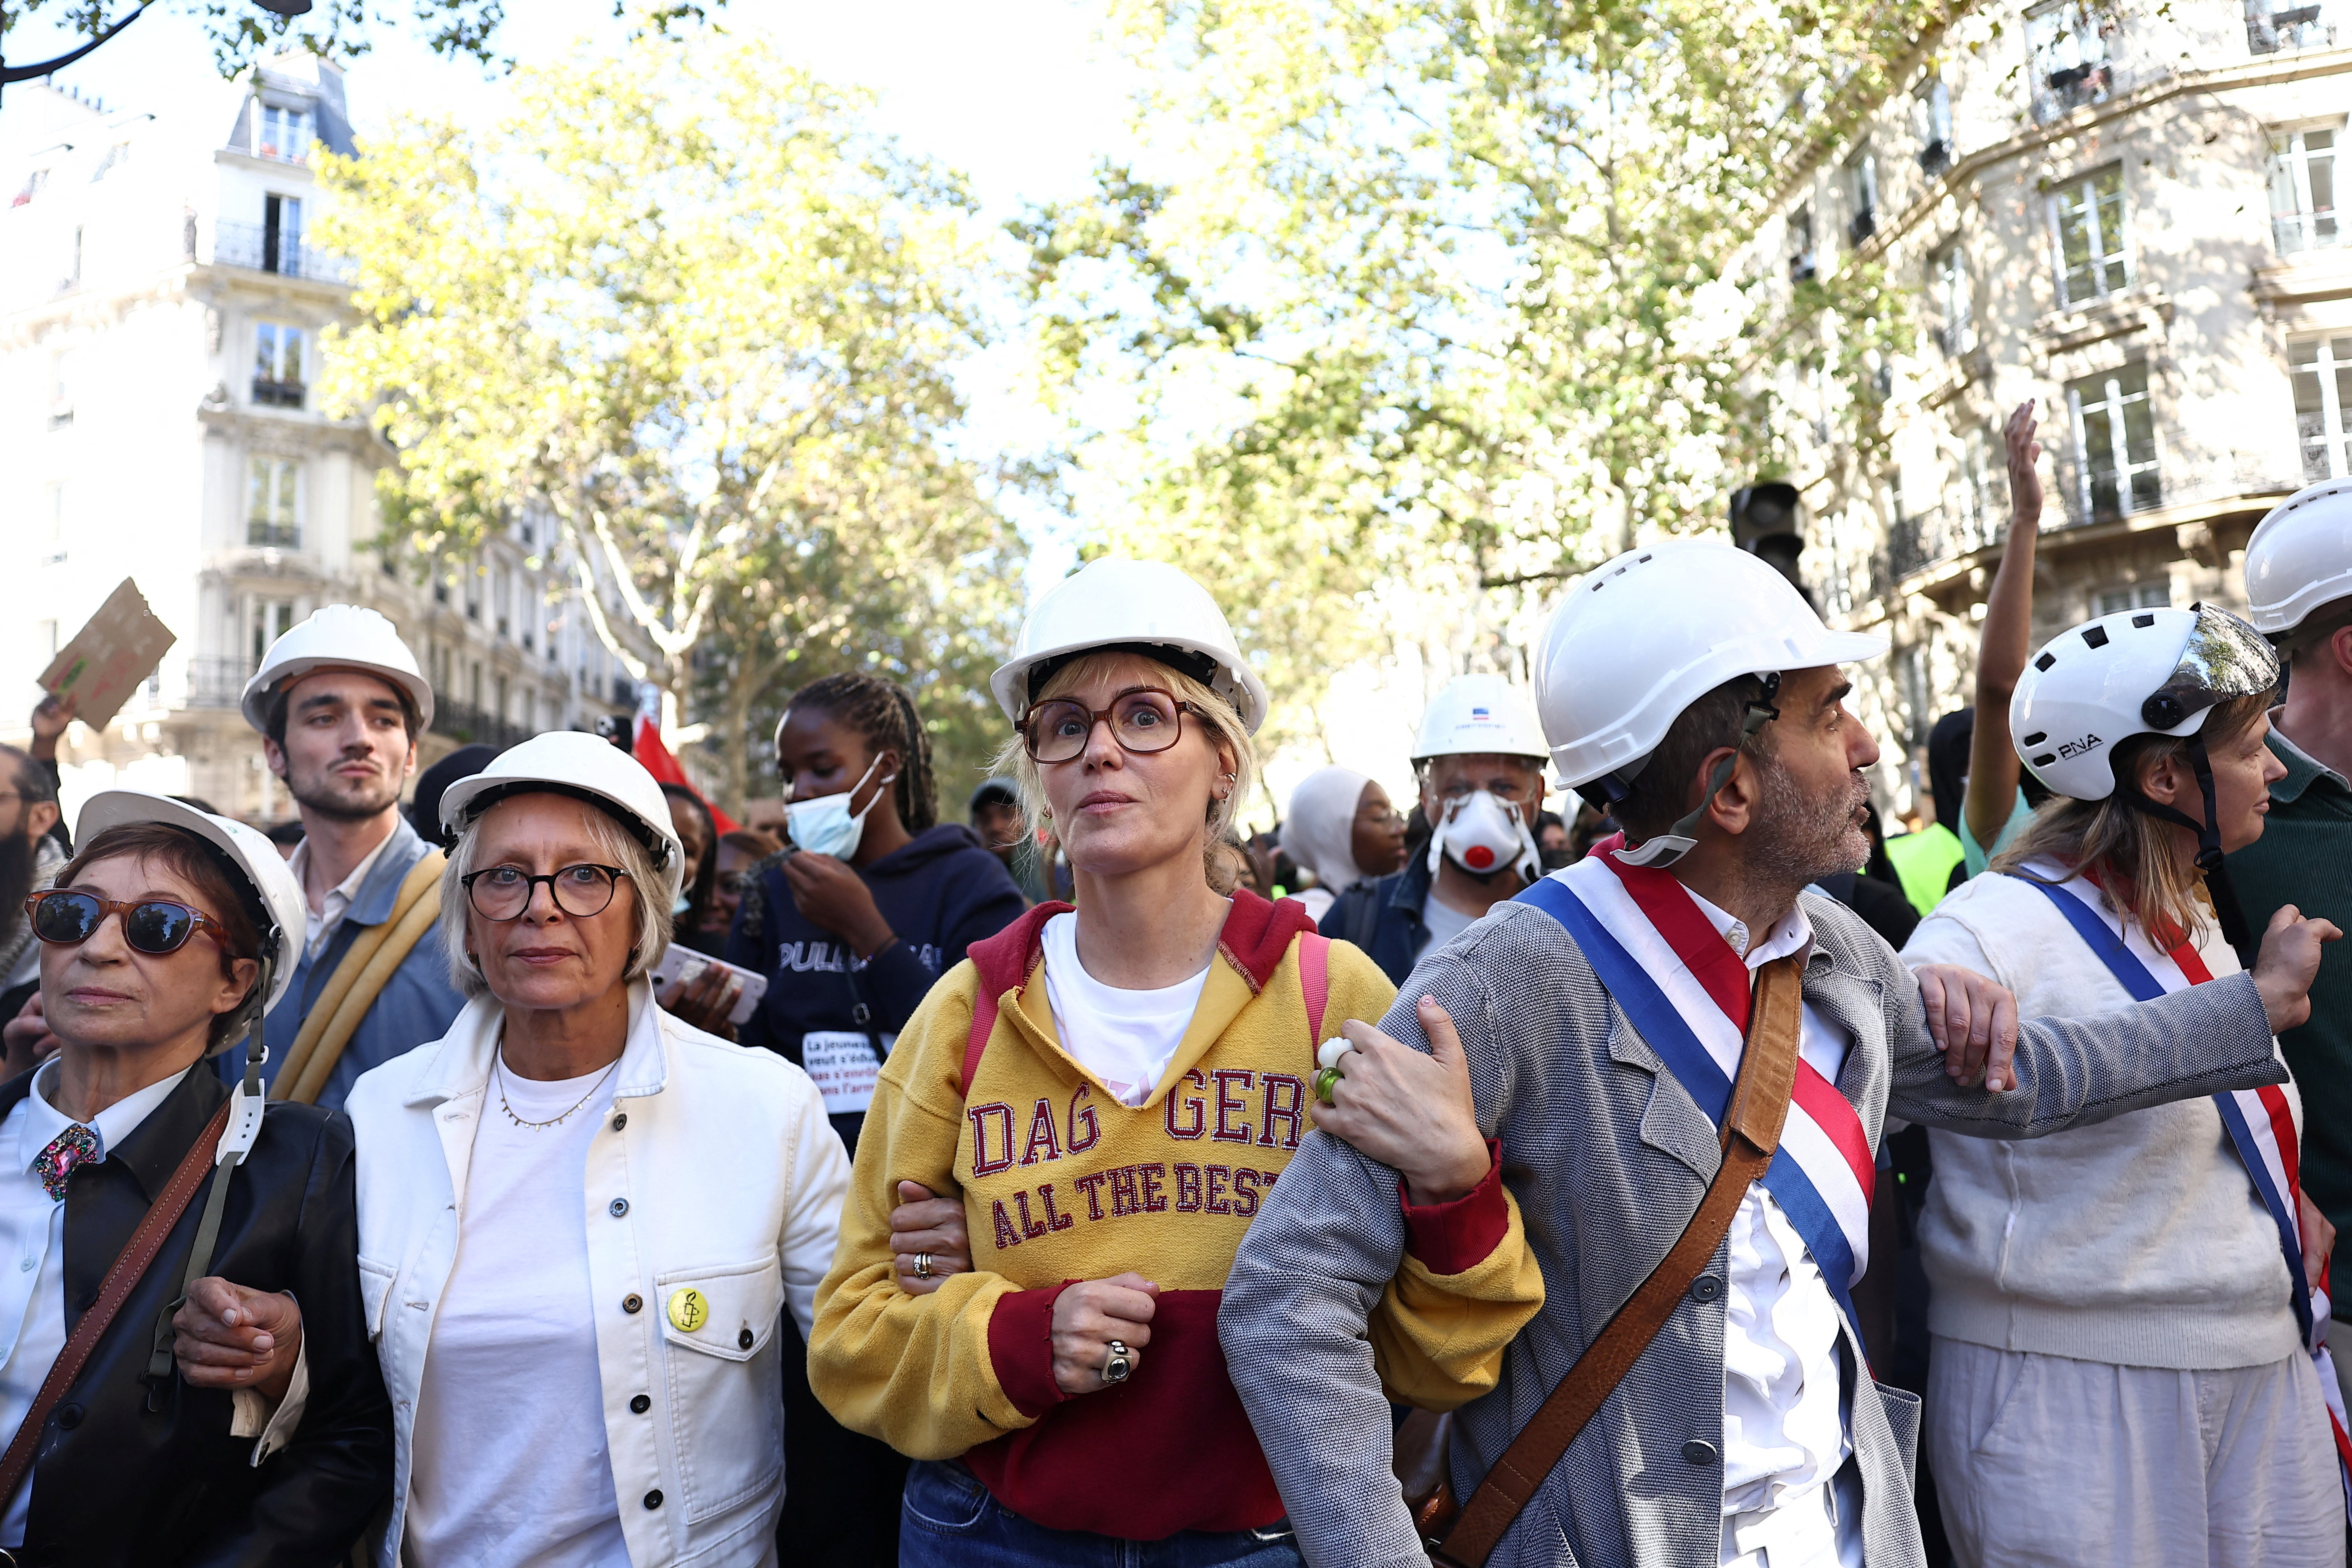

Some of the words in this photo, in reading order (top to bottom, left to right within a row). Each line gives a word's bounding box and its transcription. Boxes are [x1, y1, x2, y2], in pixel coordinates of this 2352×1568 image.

[2058, 734, 2102, 758] PNA
[968, 1081, 1102, 1178] DAG
[1164, 1067, 1306, 1151] GER
[992, 1184, 1073, 1250] ALL
[1074, 1162, 1168, 1222] THE
